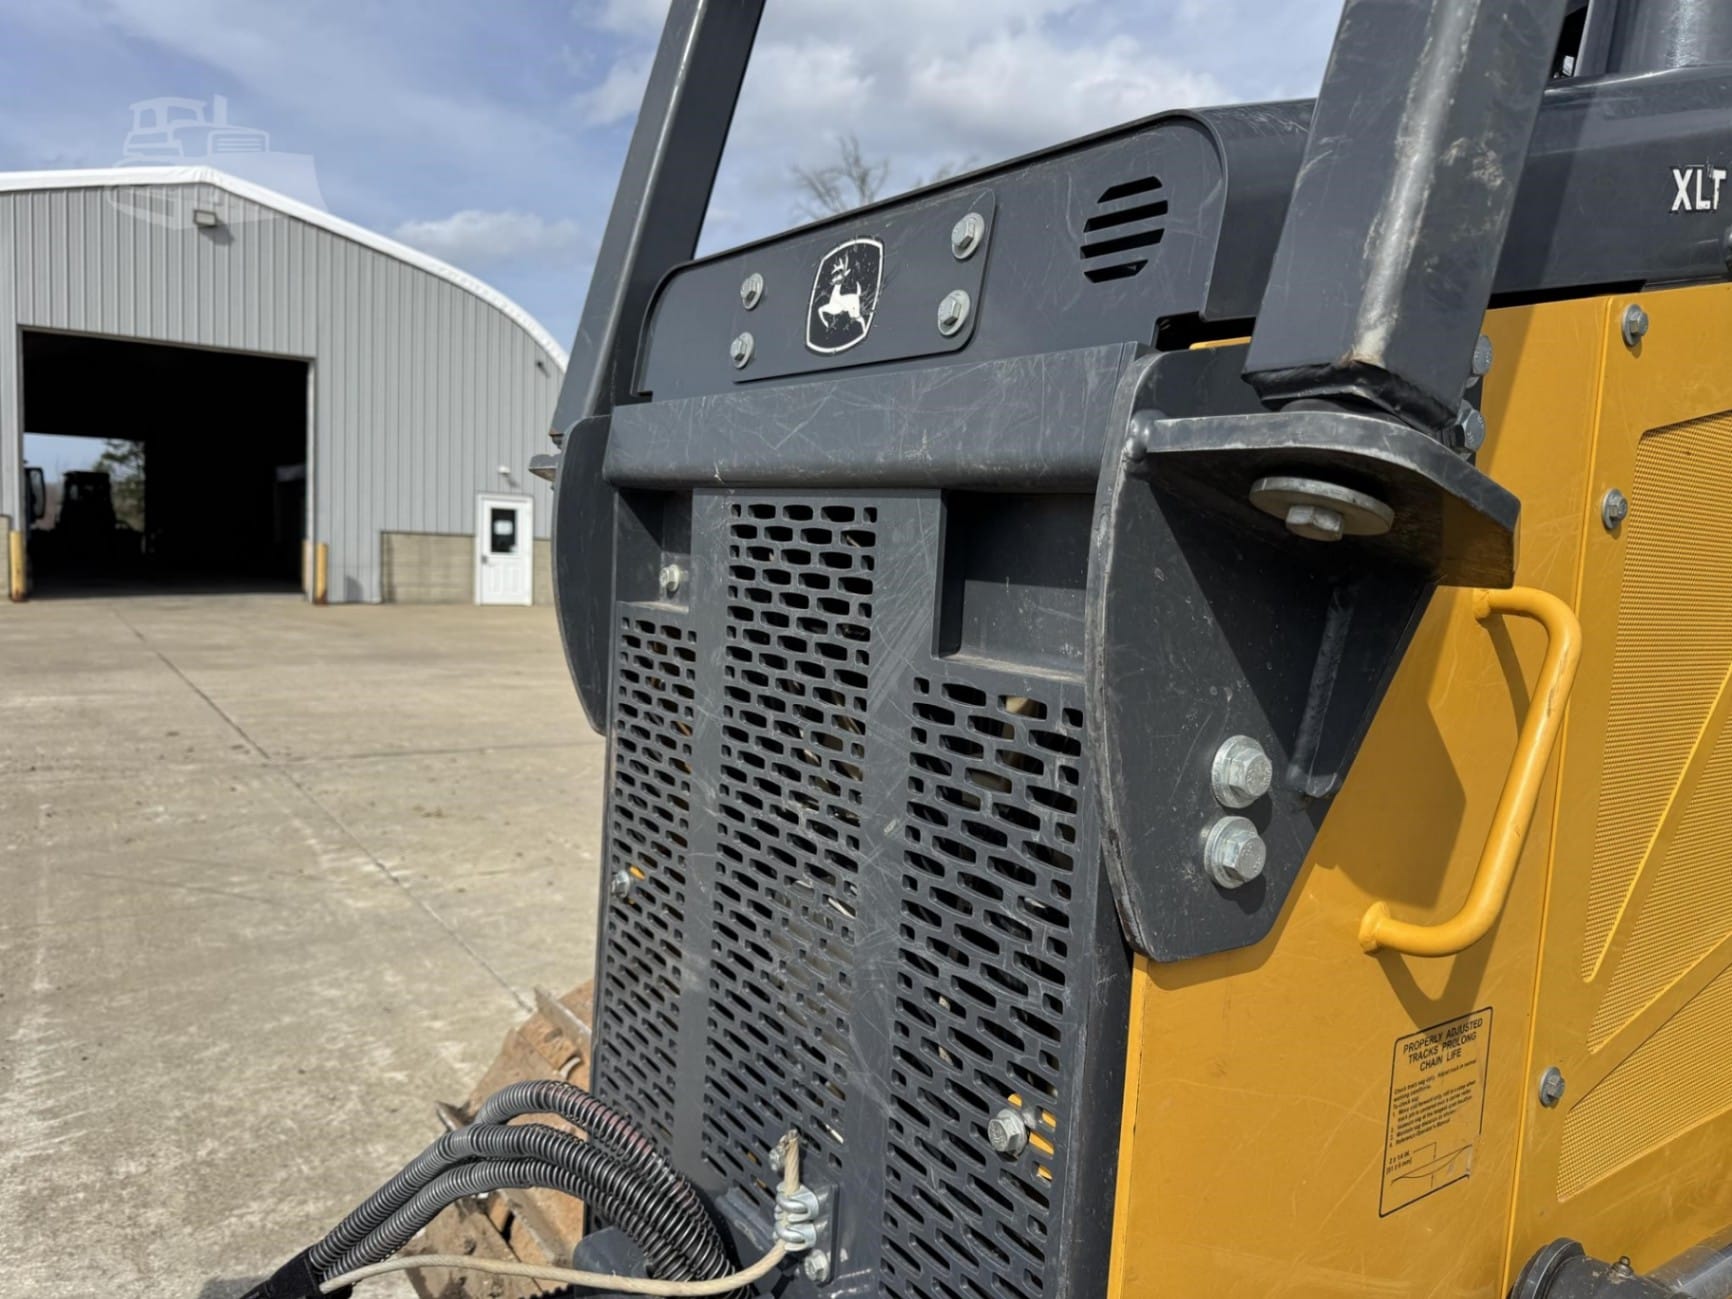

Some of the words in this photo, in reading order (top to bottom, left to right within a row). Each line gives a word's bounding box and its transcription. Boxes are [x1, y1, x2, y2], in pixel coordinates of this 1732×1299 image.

[1671, 168, 1727, 211] XLT
[1403, 1032, 1443, 1055] PROPERLY
[1446, 1018, 1483, 1039] ADJUSTED
[1409, 1045, 1438, 1064] TRACKS
[1442, 1031, 1477, 1051] PROLONG
[1420, 1056, 1443, 1072] CHAIN
[1446, 1047, 1462, 1062] LIFE
